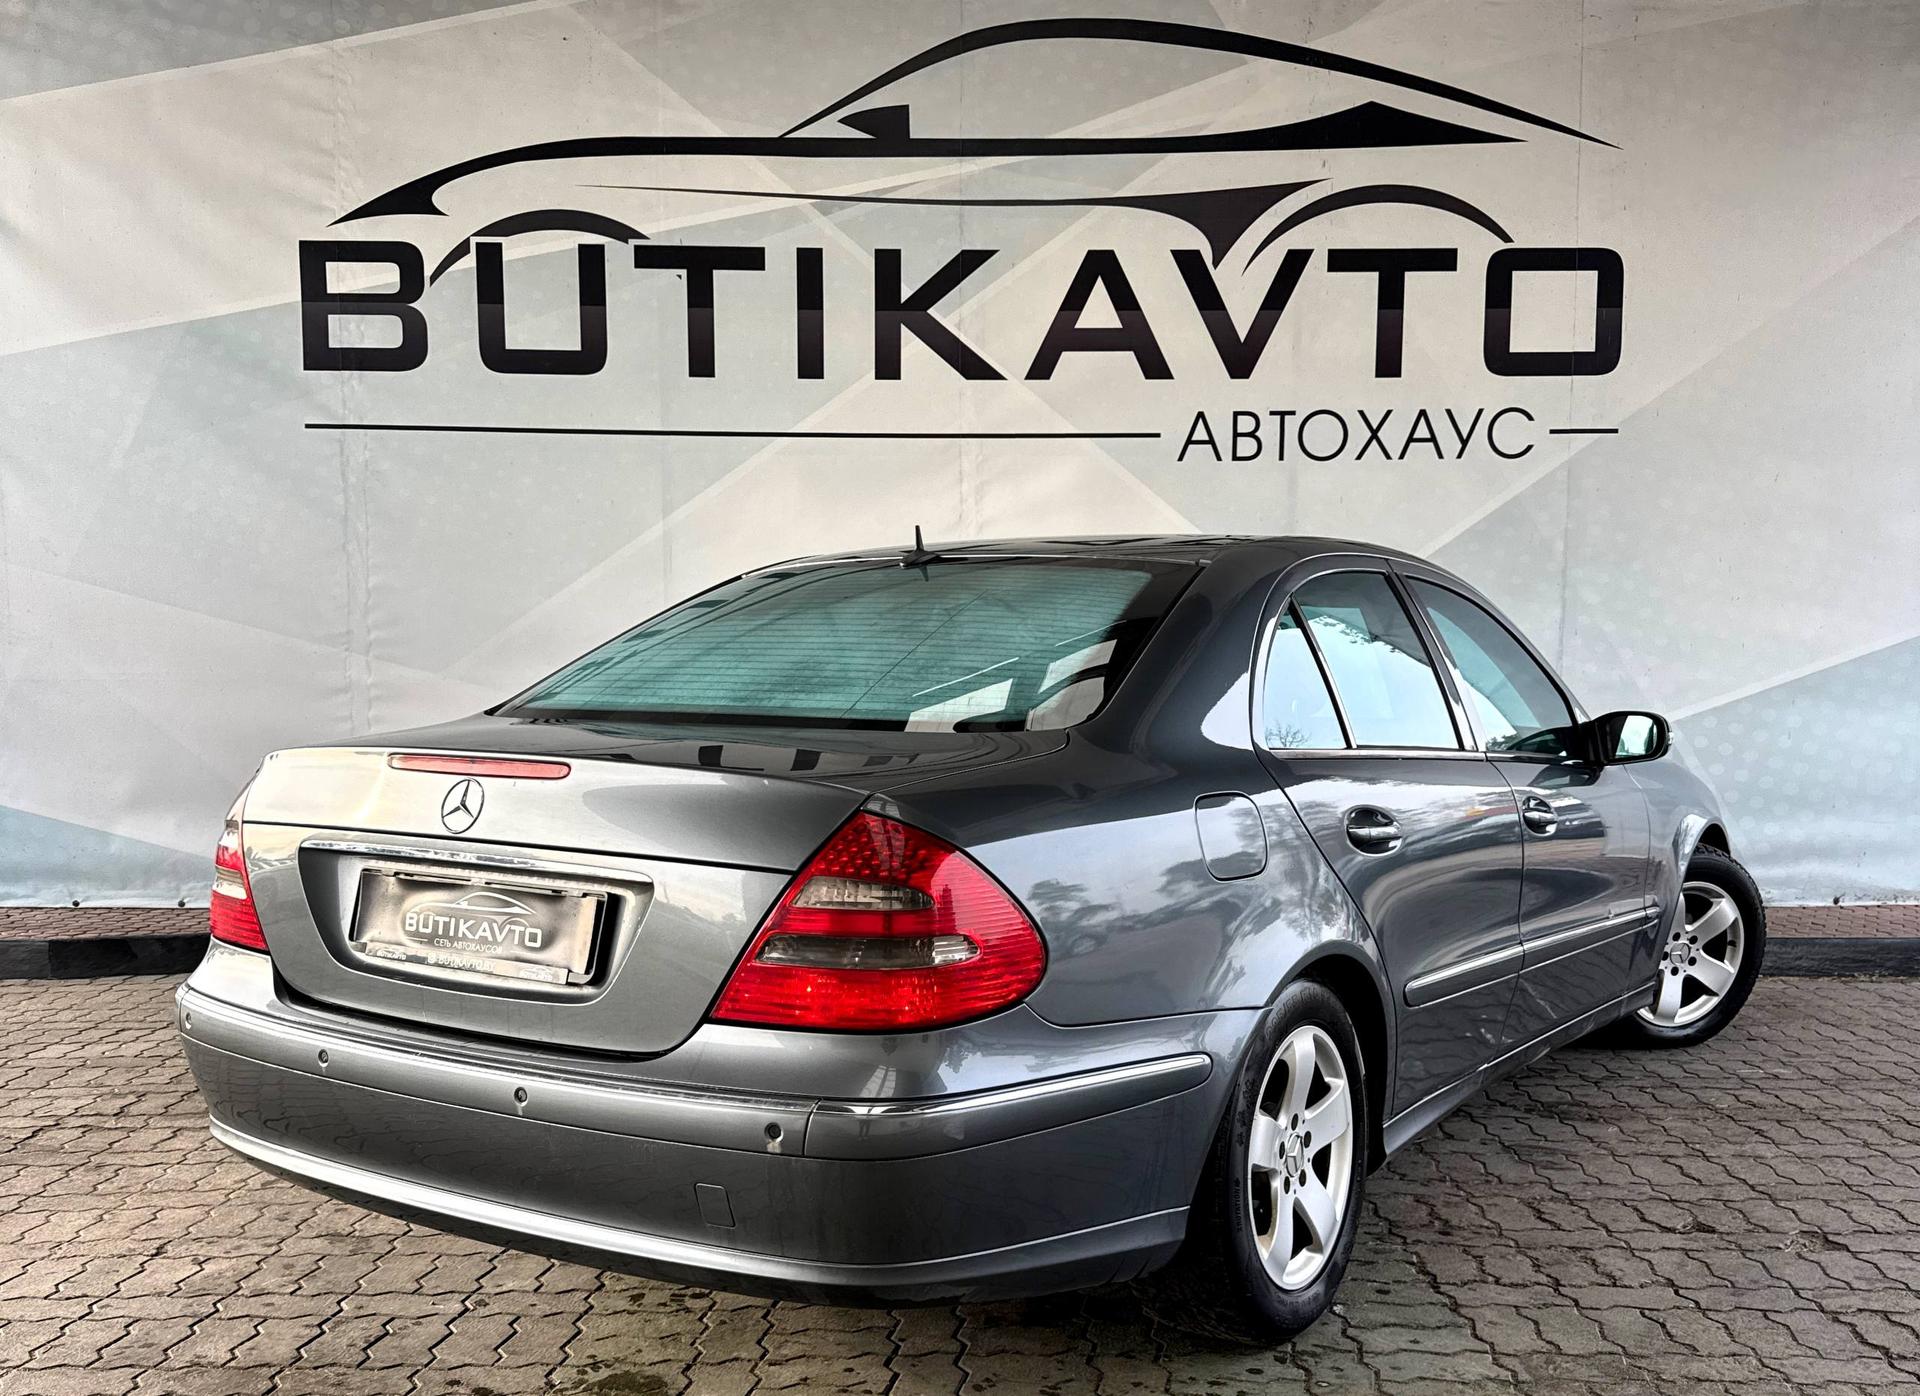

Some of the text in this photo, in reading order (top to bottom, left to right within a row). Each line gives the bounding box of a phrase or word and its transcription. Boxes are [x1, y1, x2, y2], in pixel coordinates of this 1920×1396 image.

[298, 240, 1624, 380] BUTIKAVTO
[1177, 406, 1535, 462] АВТОХАУС
[405, 912, 542, 947] BUTIKAVTO
[433, 938, 451, 947] СЕТЬ
